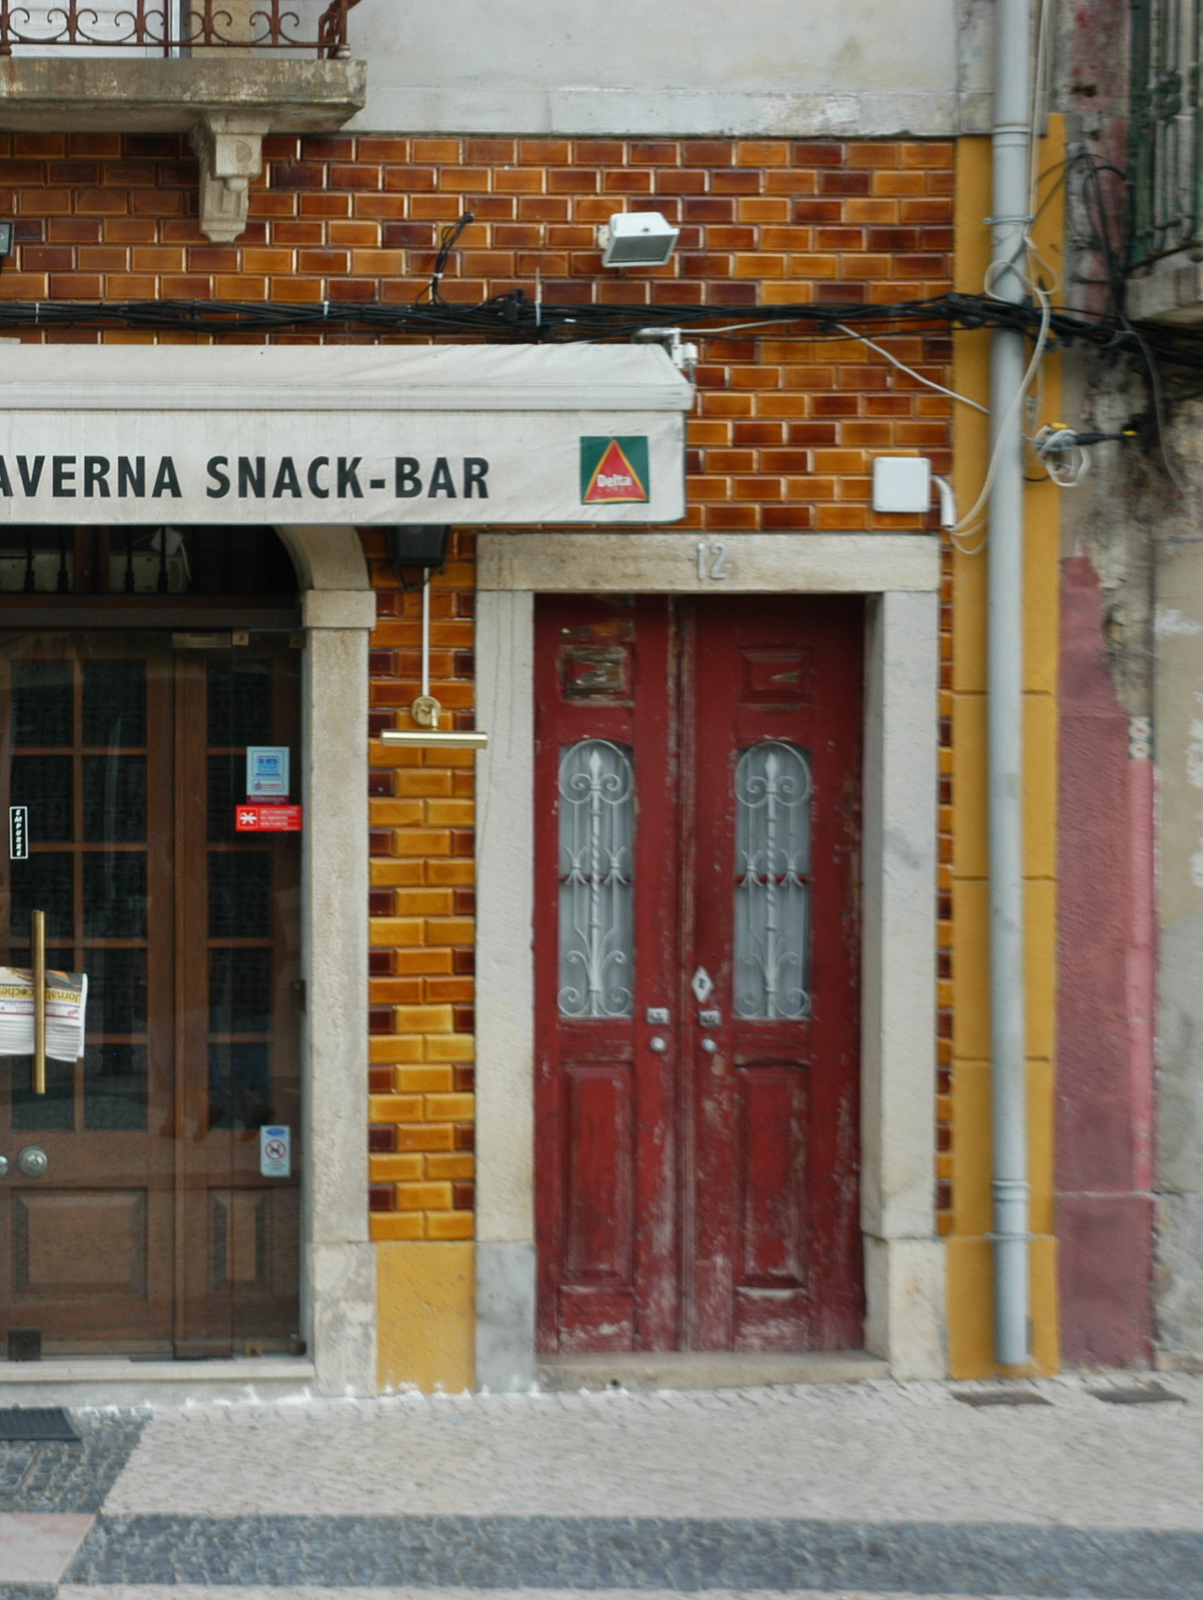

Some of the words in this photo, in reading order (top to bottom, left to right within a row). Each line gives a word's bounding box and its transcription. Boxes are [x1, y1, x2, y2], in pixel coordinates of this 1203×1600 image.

[207, 456, 488, 498] SNACK-BAR
[597, 473, 633, 488] Delta
[696, 541, 728, 580] 12
[13, 808, 23, 857] EMPURRE
